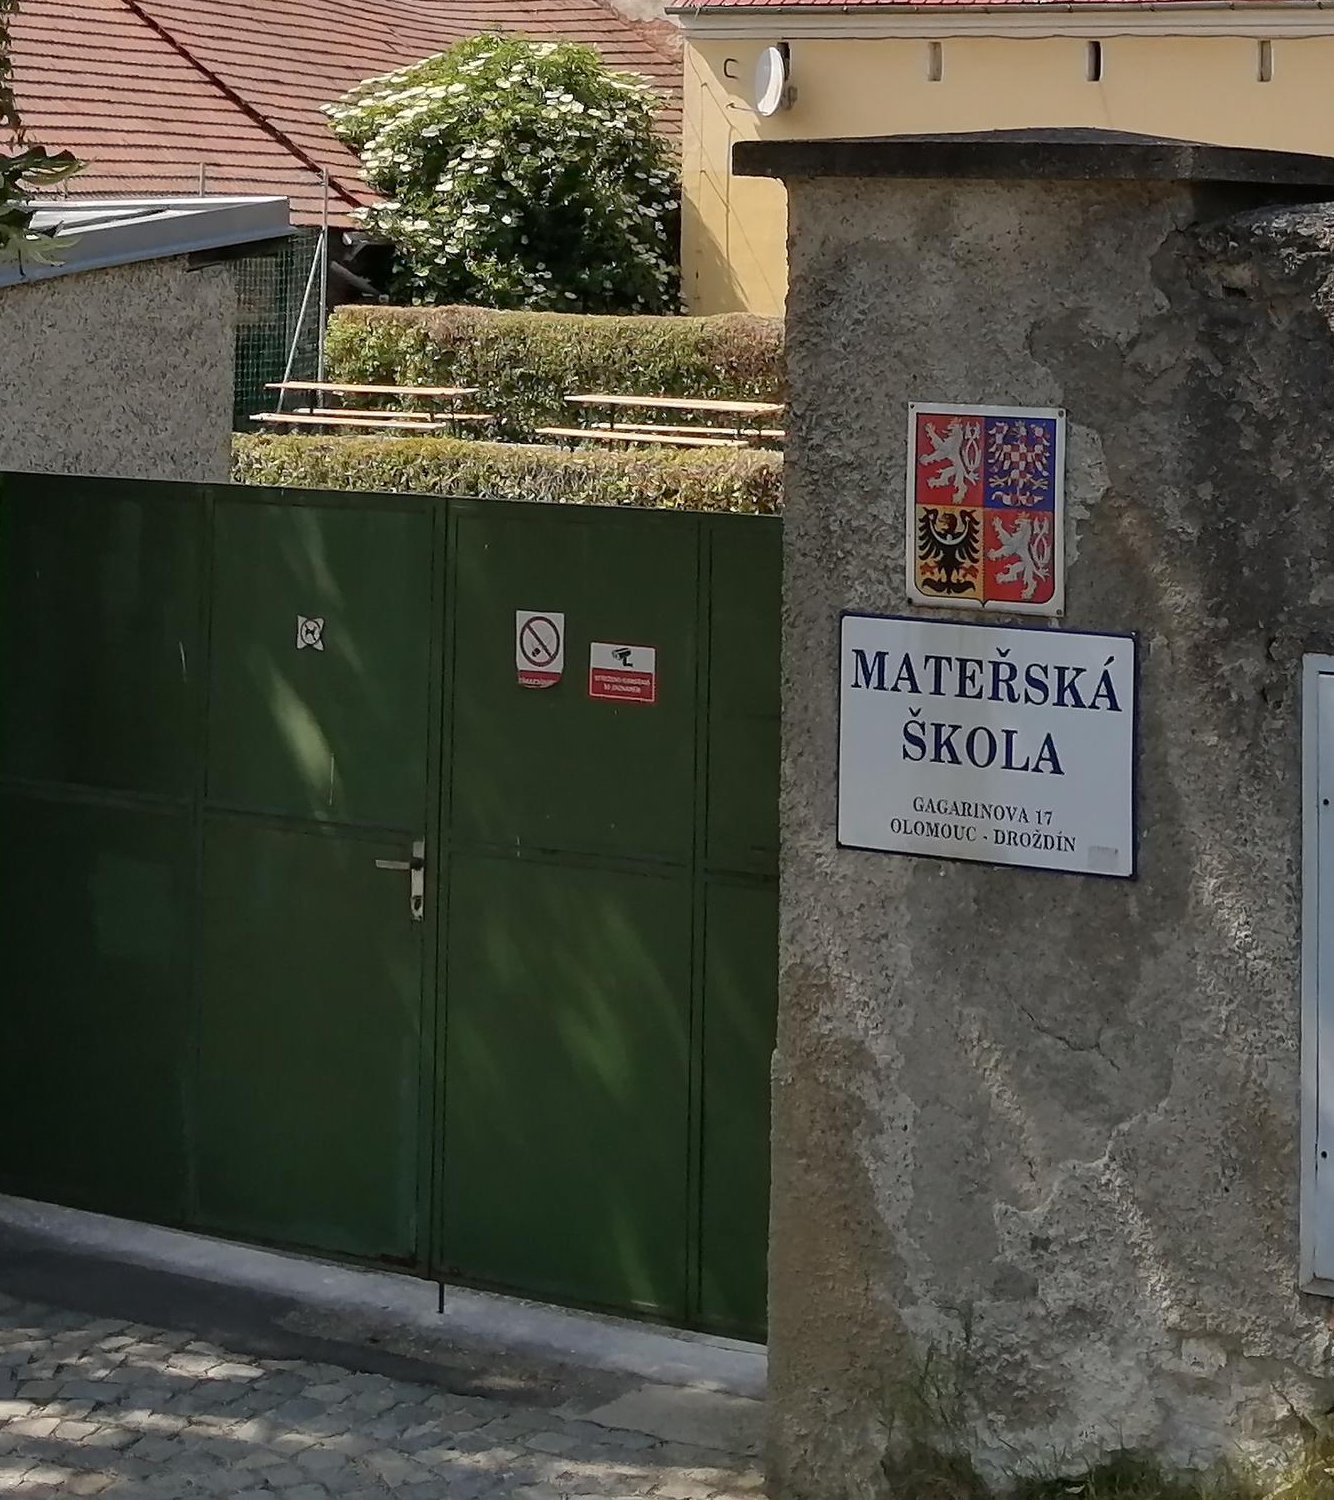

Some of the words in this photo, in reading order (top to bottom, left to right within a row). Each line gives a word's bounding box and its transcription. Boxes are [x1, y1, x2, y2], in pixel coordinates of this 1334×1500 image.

[851, 647, 1122, 712] MATEŘSKÁ
[903, 707, 1065, 775] ŠKOLA
[890, 818, 977, 842] OLOMOUC
[993, 829, 1076, 852] DROŽDÍN
[913, 796, 1029, 824] GAGARINOVA
[1035, 809, 1053, 826] 17
